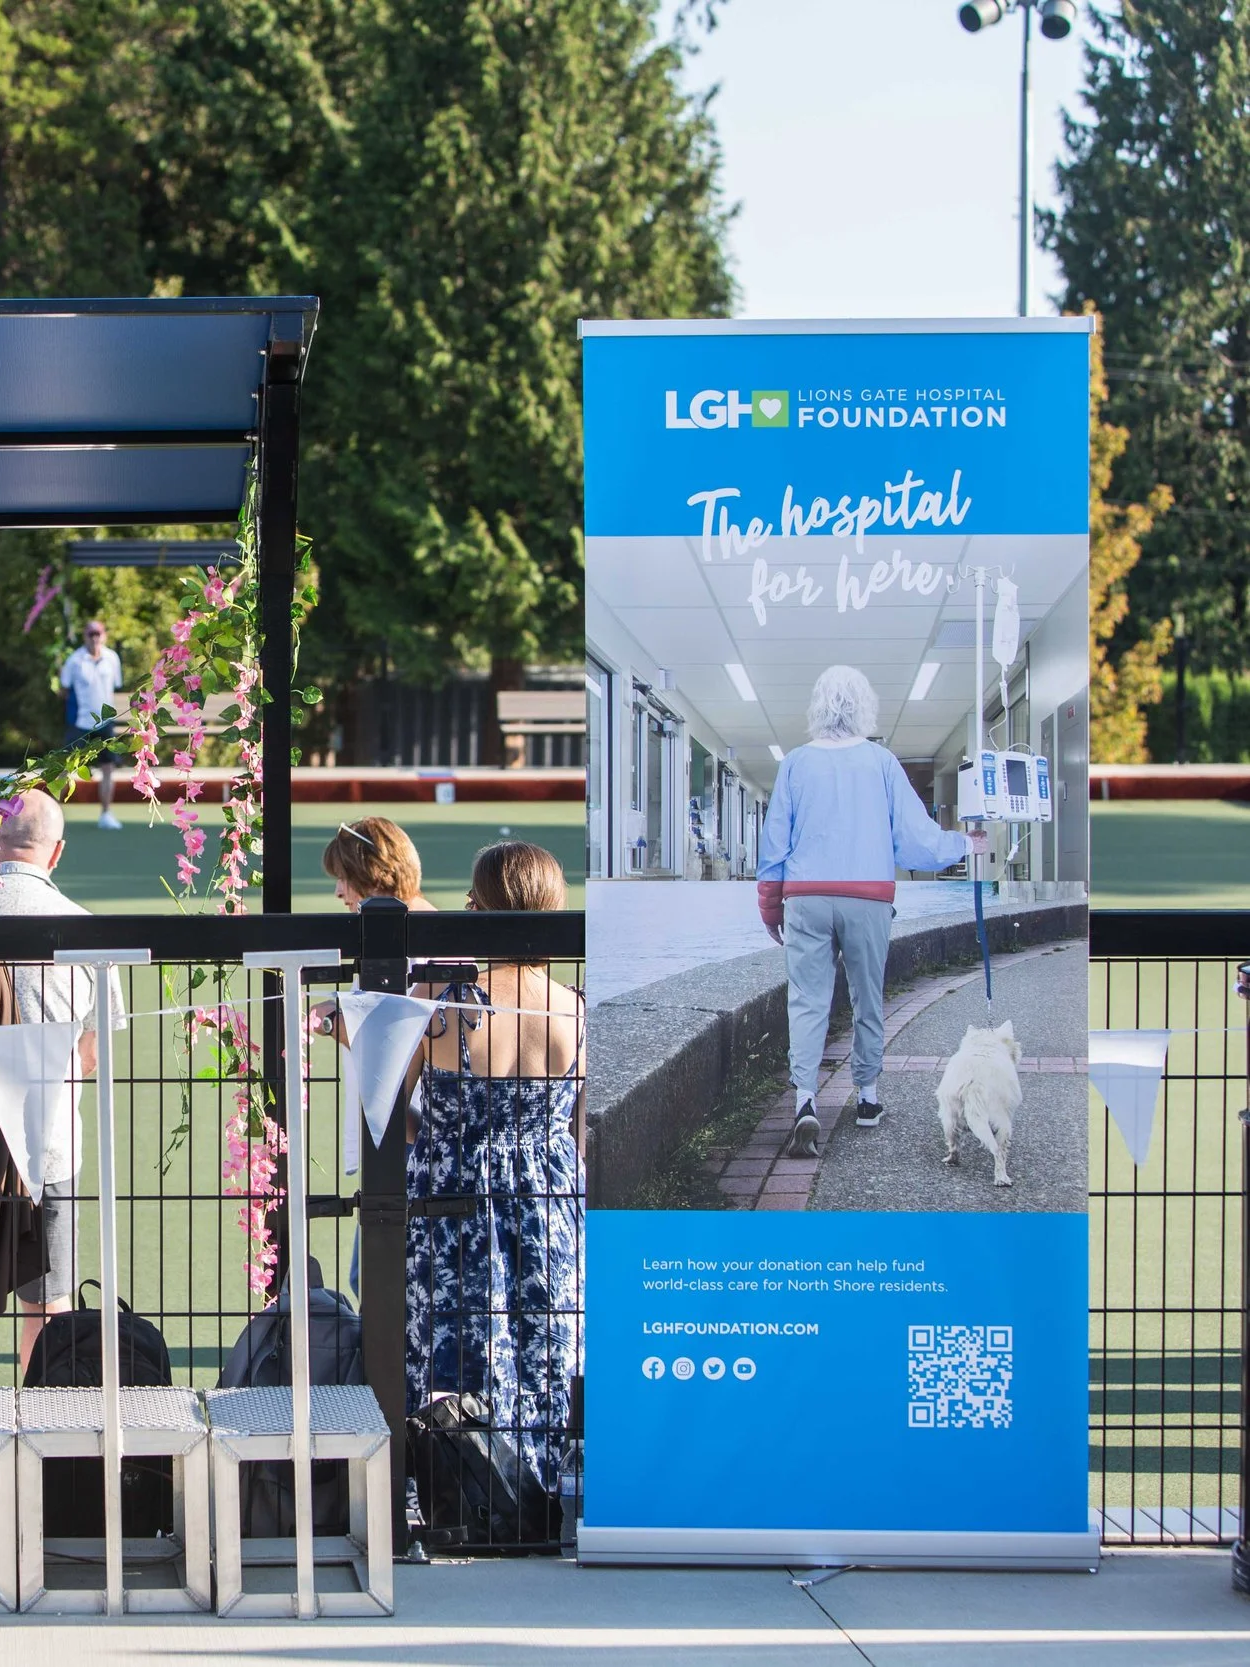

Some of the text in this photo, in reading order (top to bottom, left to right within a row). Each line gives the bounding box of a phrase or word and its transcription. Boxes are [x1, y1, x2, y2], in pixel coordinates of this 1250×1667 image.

[797, 388, 1006, 402] LIONS GATE HOSPITAL
[665, 389, 753, 430] LGH
[797, 406, 1007, 428] FOUNDATION
[687, 468, 972, 562] The hospital
[747, 557, 824, 626] for
[642, 1258, 925, 1275] Learn how your donation can help fund
[642, 1278, 949, 1293] world-class care for North Shore residents.
[642, 1321, 820, 1336] LGHFOUNDATION.COM
